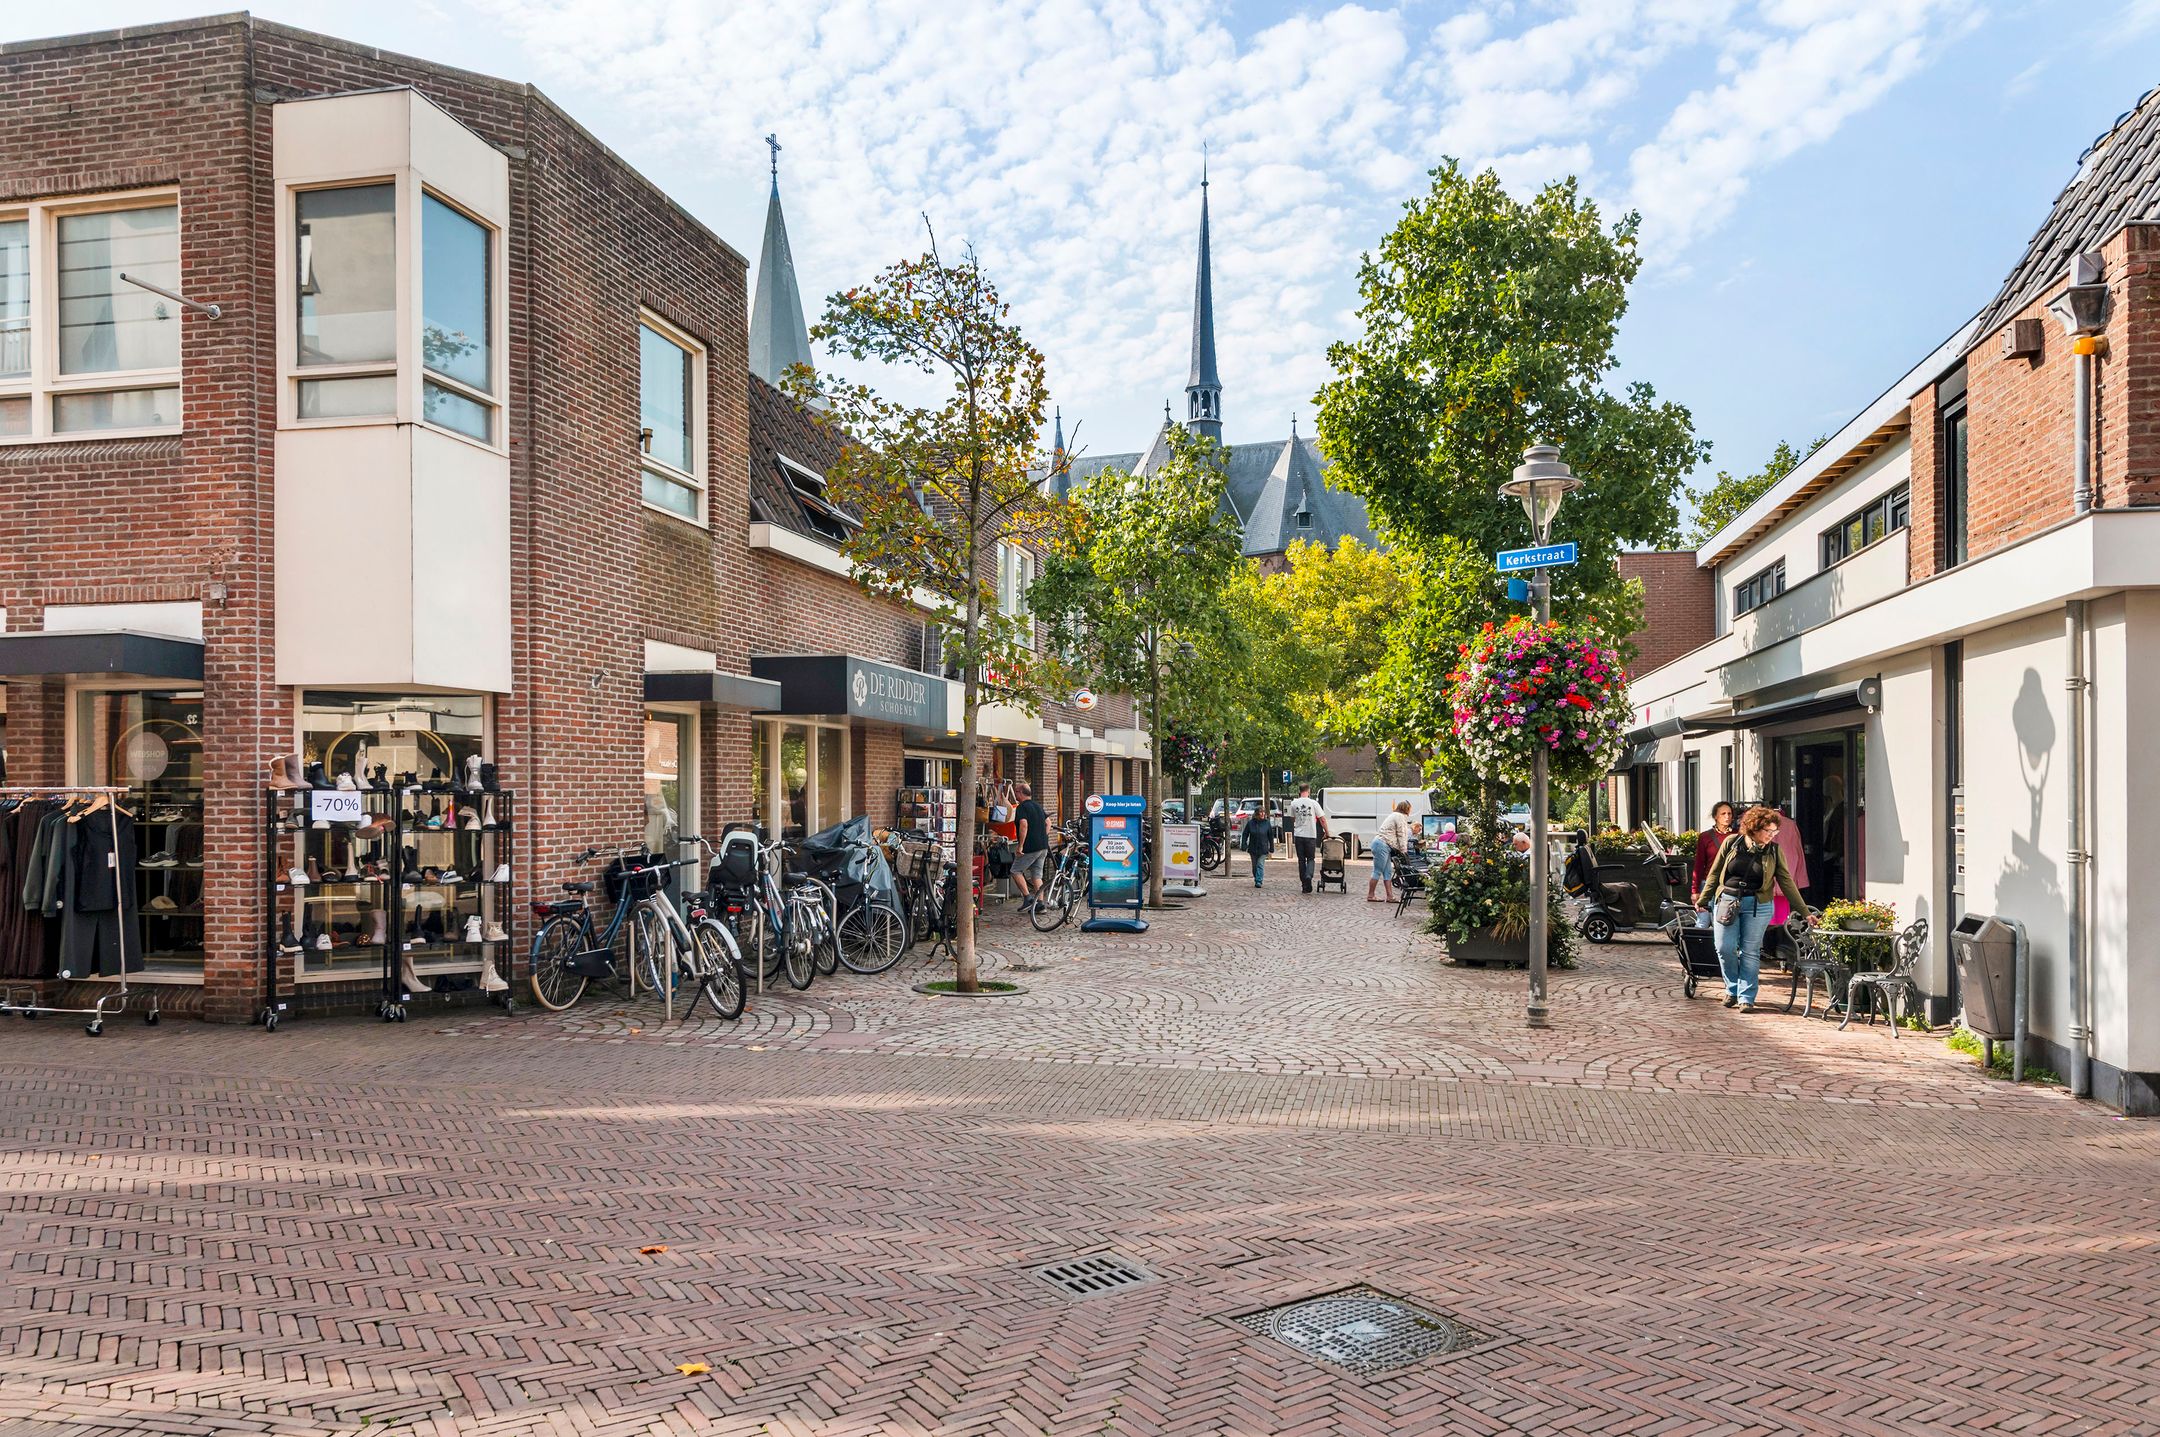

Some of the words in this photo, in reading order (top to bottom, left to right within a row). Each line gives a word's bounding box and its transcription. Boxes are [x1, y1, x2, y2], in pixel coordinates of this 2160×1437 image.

[1506, 550, 1565, 566] Kerkstraat
[870, 671, 885, 696] DE
[888, 676, 926, 704] RIDDER
[880, 701, 918, 717] SCHOENEN
[316, 798, 359, 812] -70%
